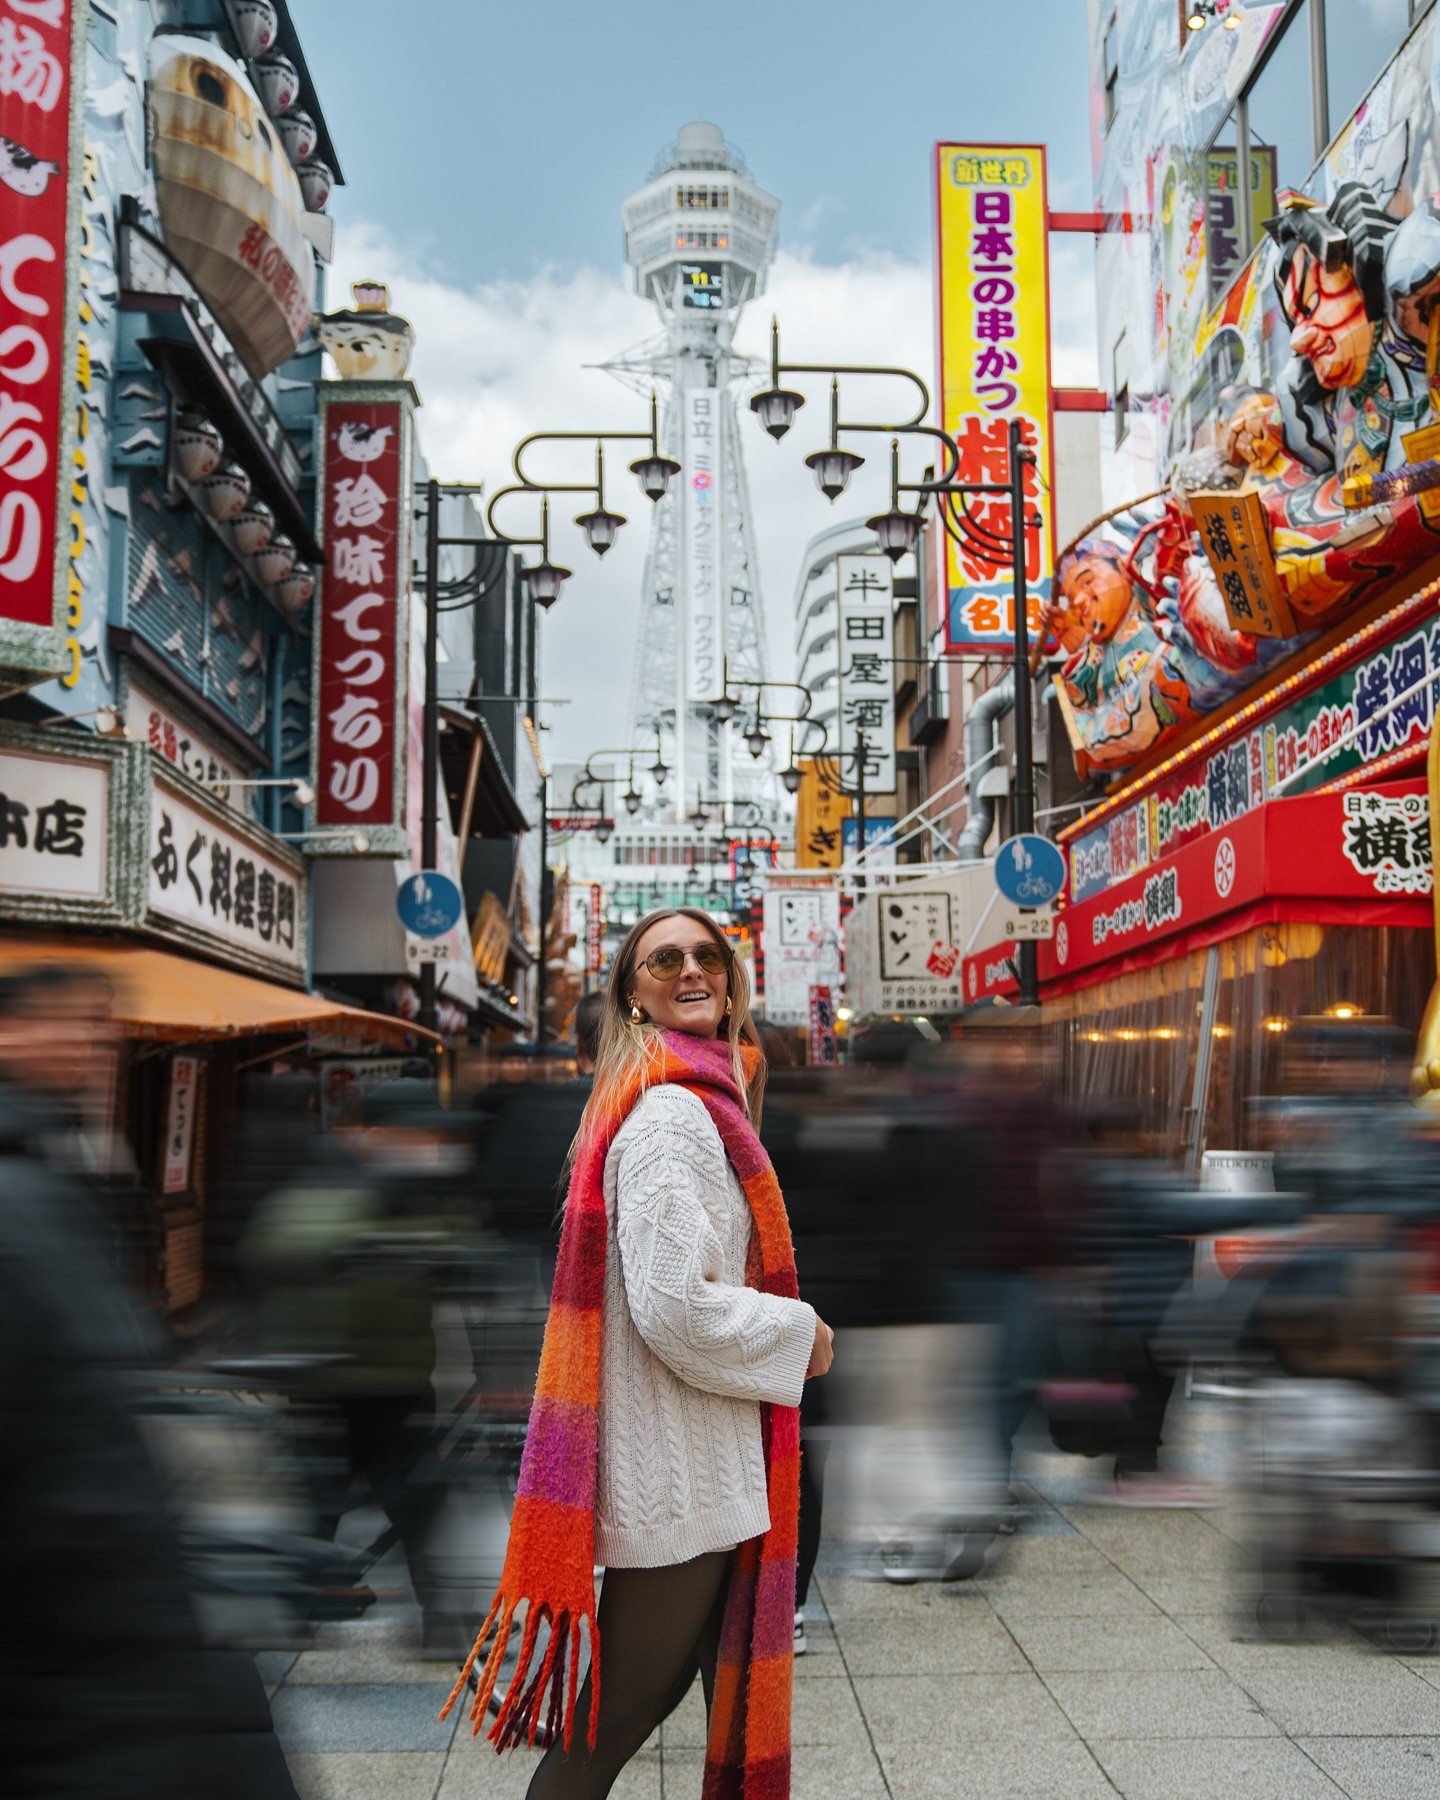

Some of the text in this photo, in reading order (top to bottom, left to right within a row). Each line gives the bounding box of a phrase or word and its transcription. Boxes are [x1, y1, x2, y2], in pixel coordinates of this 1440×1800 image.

[973, 191, 1018, 410] 日本一の串かつ
[151, 811, 296, 950] ふぐ料理専門
[1005, 919, 1049, 936] 9-22
